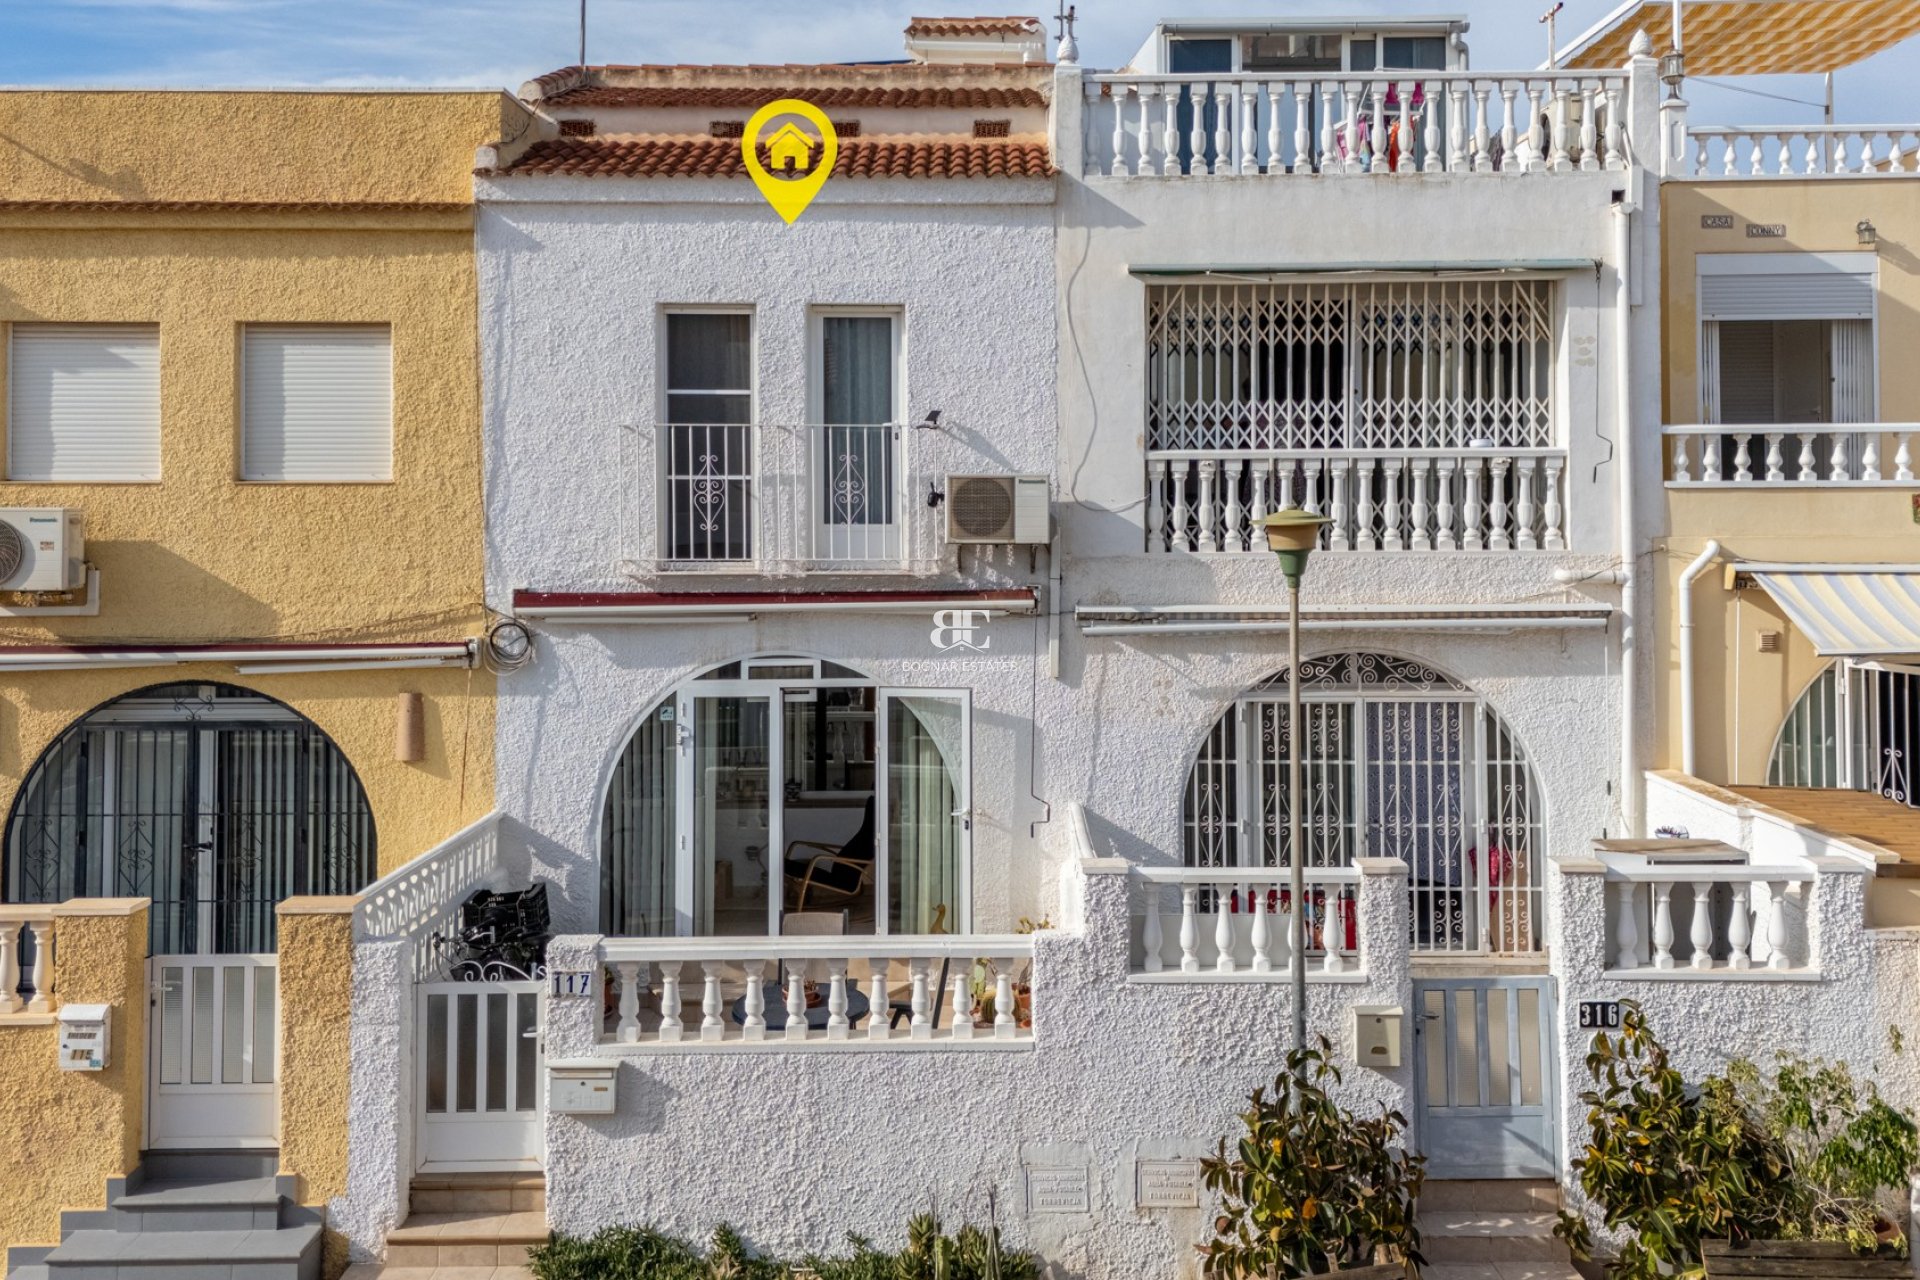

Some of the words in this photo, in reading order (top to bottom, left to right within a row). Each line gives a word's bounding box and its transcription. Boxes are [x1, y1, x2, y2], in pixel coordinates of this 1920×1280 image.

[1705, 217, 1731, 227] CASA
[554, 974, 590, 994] 117
[1581, 1004, 1618, 1026] 316
[70, 1049, 94, 1061] 115
